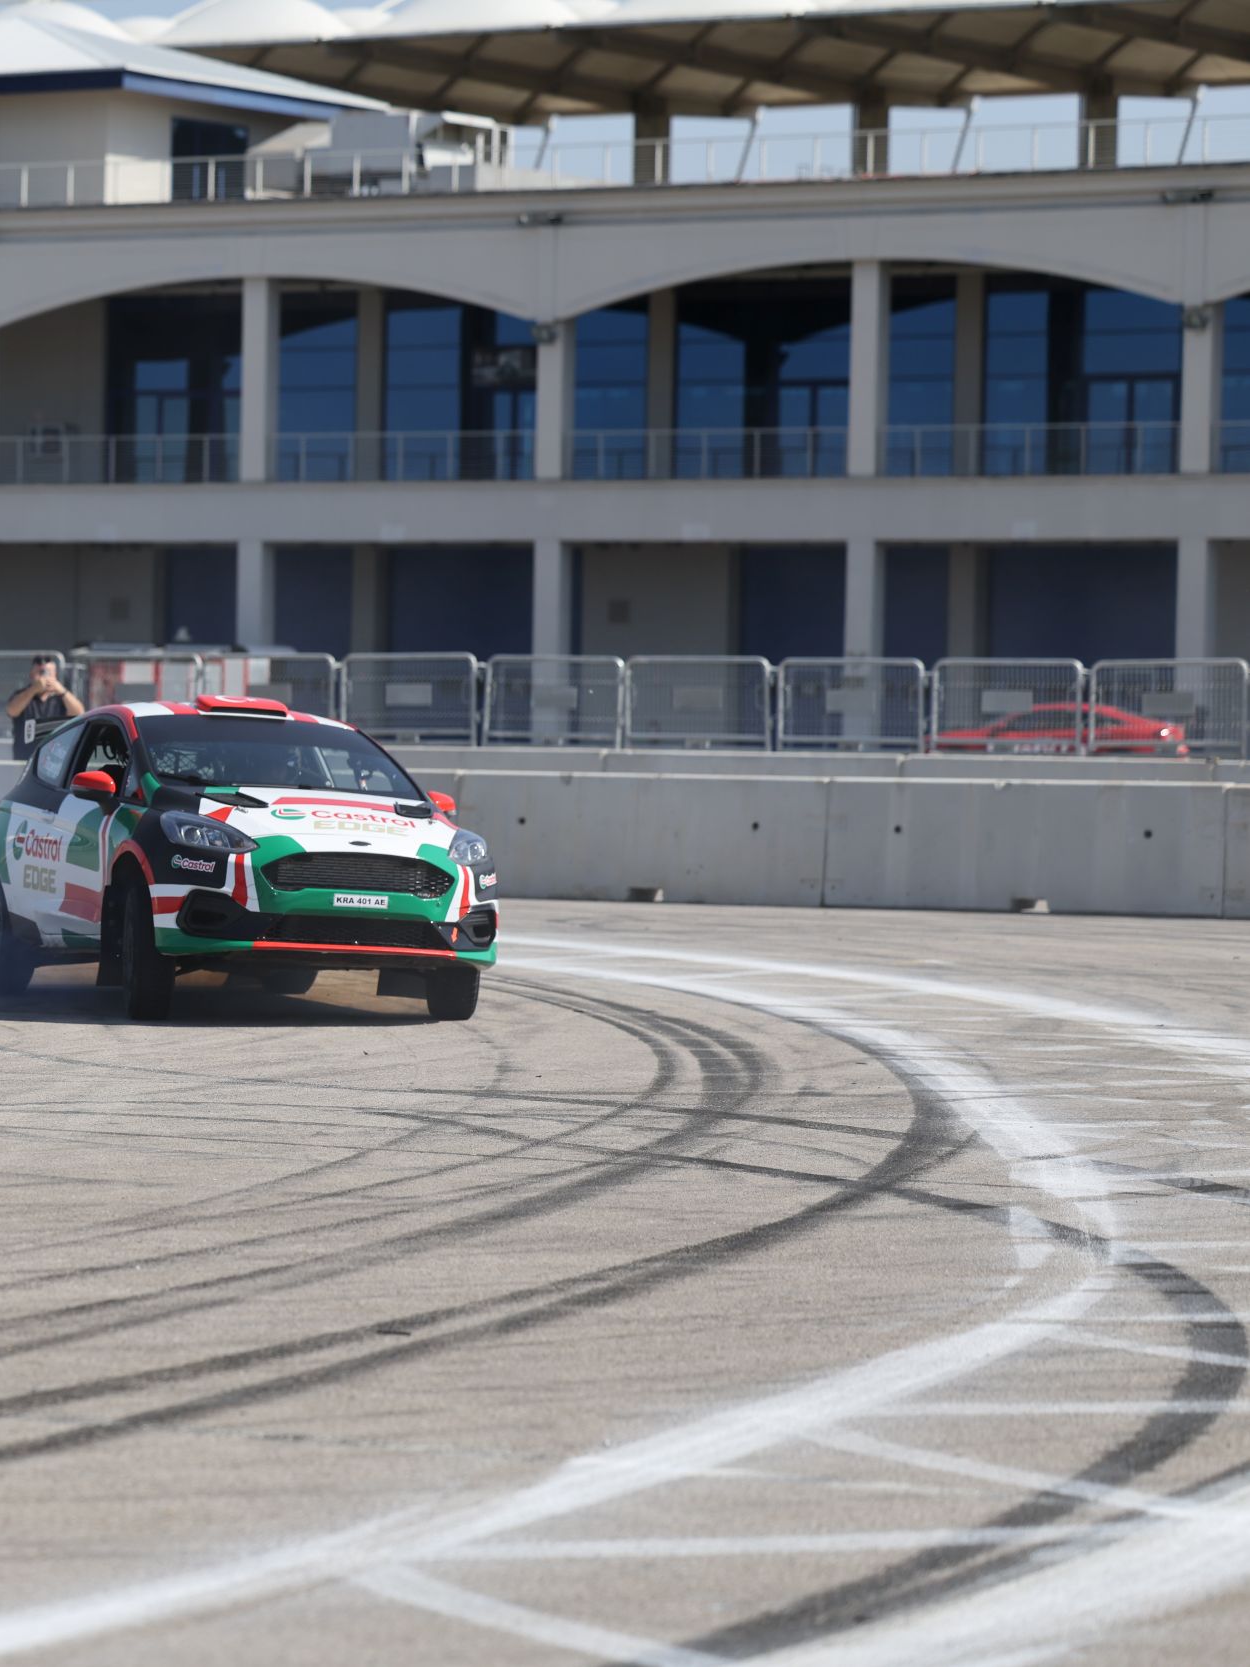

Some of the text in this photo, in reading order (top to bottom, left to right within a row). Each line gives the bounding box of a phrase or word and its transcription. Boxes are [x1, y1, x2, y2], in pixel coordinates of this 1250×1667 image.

[310, 810, 416, 829] Castrol
[313, 820, 409, 837] EDGE
[24, 829, 63, 862] Castrol
[181, 858, 216, 872] Castrol
[23, 864, 57, 894] EDGE
[336, 896, 386, 907] KRA 401 AE
